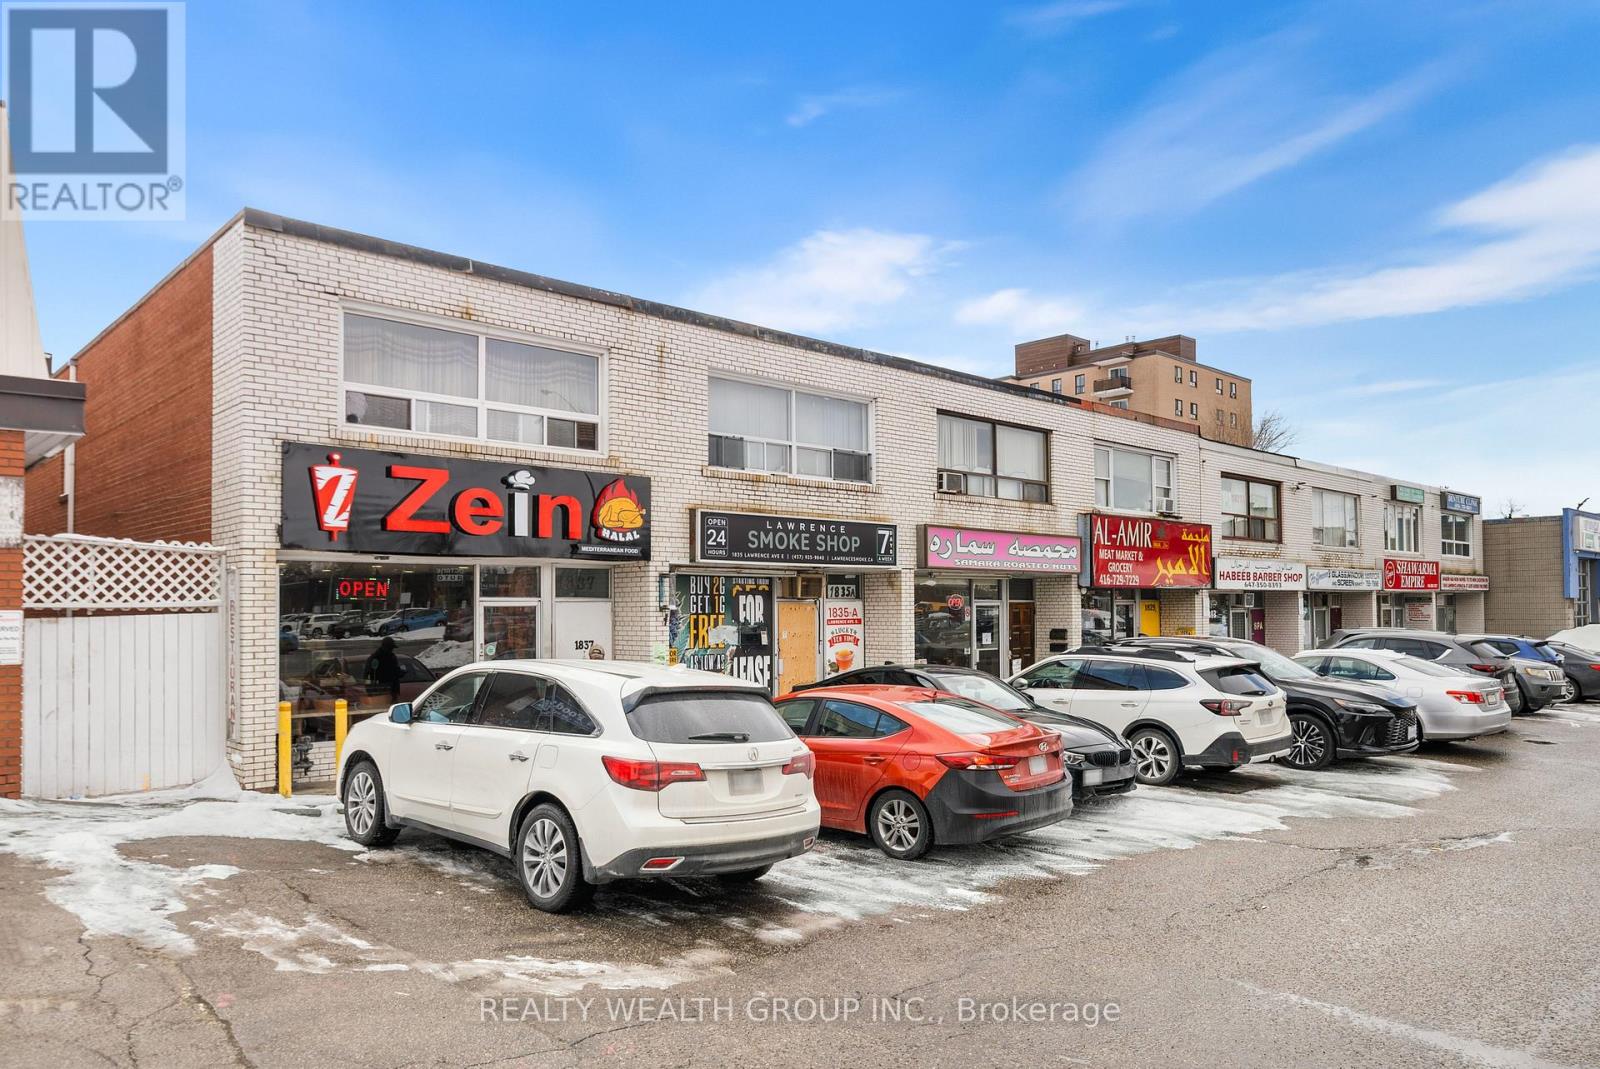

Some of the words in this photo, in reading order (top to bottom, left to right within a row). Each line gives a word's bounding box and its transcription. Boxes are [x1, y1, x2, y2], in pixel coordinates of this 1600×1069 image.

[381, 464, 583, 540] Zein
[601, 527, 640, 541] HALAL
[766, 520, 846, 534] LAWRENCE
[1094, 517, 1152, 548] AL-AMIR
[707, 529, 726, 546] 24
[747, 530, 810, 551] SMOKE
[816, 534, 860, 552] SHOP
[877, 530, 890, 554] 7
[1099, 549, 1115, 559] MEAT
[1115, 550, 1138, 561] MARKET
[1138, 552, 1144, 561] &
[954, 559, 1001, 567] SAMARA
[1003, 561, 1050, 569] ROASTED
[1052, 563, 1078, 571] NUTS
[1107, 562, 1134, 573] GROCERY
[1396, 561, 1437, 575] SHAWARMA
[1219, 571, 1252, 581] HABEEB
[1252, 572, 1282, 582] BARBER
[1283, 573, 1303, 582] SHOP
[1401, 575, 1426, 588] EMPIRE
[339, 580, 389, 597] OPEN
[690, 575, 710, 594] BUY
[713, 576, 726, 595] 2G
[690, 595, 710, 614] GET
[714, 595, 726, 614] 1G
[738, 594, 765, 626] FOR
[574, 640, 595, 650] 1837
[690, 654, 699, 670] AS
[716, 654, 726, 670] AS
[732, 655, 771, 688] LEASE
